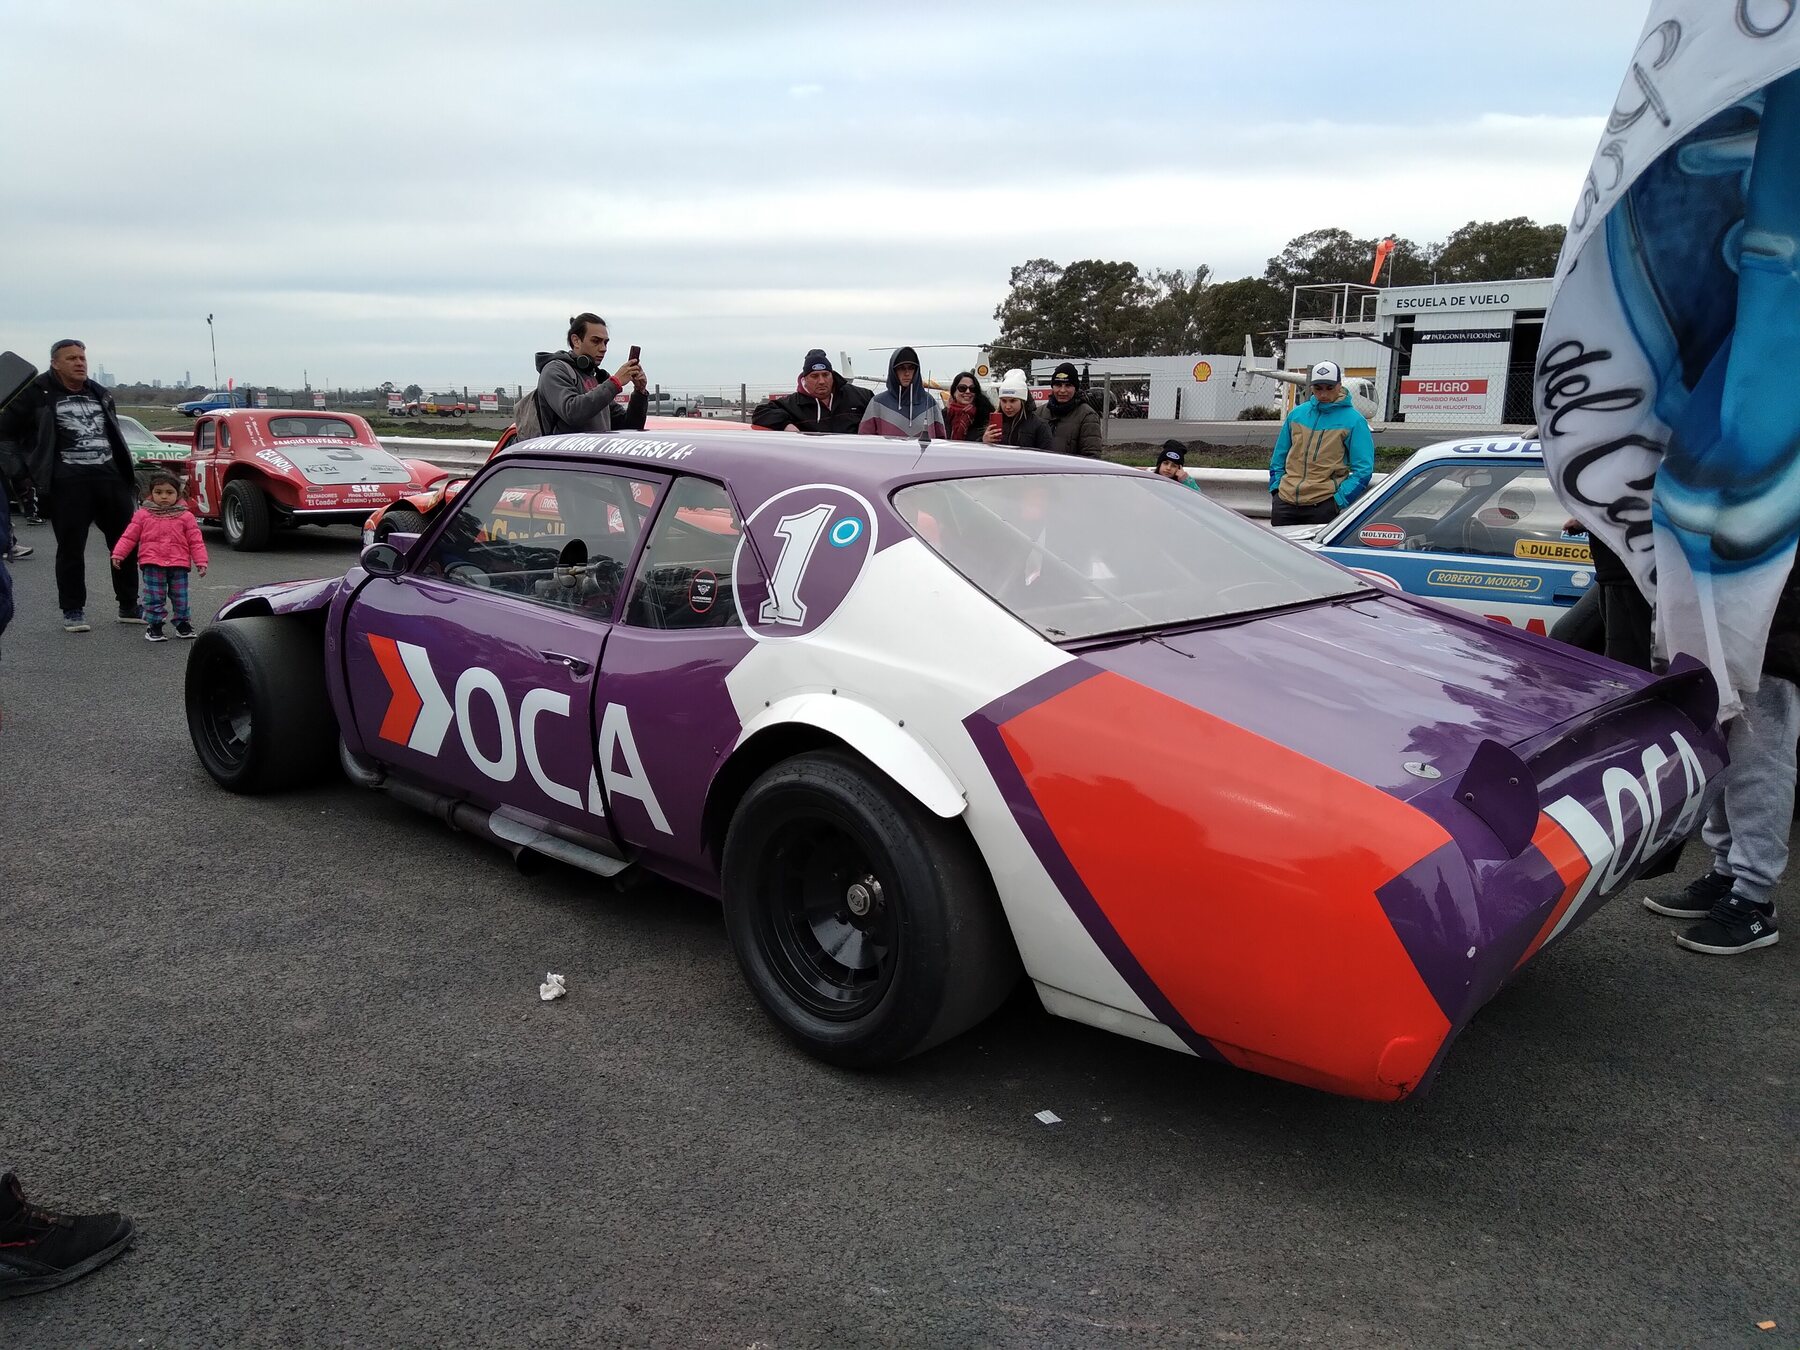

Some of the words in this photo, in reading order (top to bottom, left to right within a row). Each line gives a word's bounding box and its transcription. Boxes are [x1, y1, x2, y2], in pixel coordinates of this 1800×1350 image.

[1396, 297, 1447, 308] ESCUELA
[1450, 296, 1466, 306] DE
[1469, 294, 1510, 305] VUELO
[1431, 332, 1466, 340] PATAGONIA
[1418, 382, 1470, 392] PELIGRO
[316, 447, 364, 461] 3
[598, 438, 671, 459] TRAVERSO
[195, 460, 211, 514] 3
[351, 484, 380, 493] SKF
[1361, 530, 1403, 541] MOLYKOTE
[1530, 544, 1593, 560] DULBECC
[1436, 572, 1482, 585] ROBERTO
[1484, 576, 1532, 589] MOURAS
[454, 666, 675, 837] OCA
[1599, 730, 1707, 896] OCA
